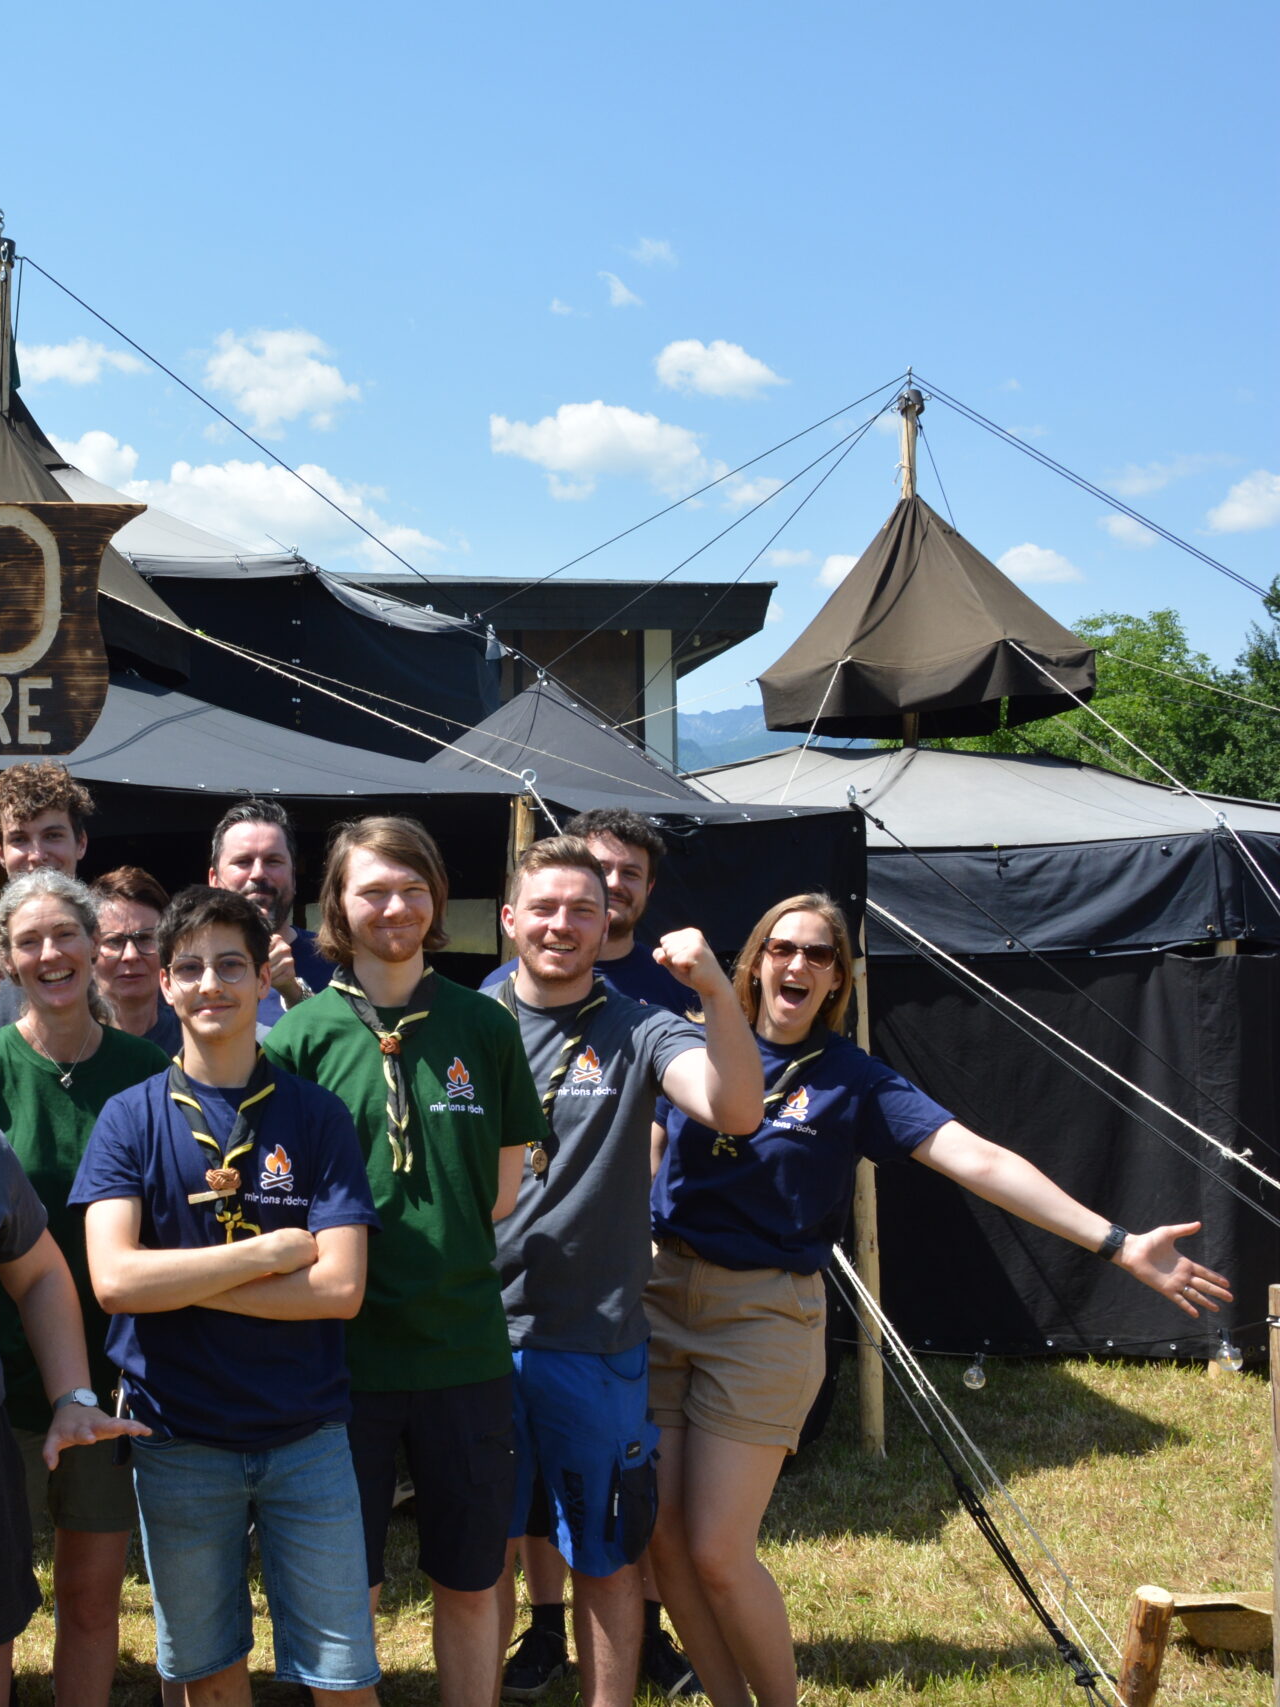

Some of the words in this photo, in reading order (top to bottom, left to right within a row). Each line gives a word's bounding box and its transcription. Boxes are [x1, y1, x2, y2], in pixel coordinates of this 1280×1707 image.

[571, 1086, 591, 1097] lons
[592, 1086, 617, 1097] röcha
[429, 1101, 447, 1112] mir
[448, 1102, 466, 1112] lons
[467, 1103, 485, 1115] röch
[772, 1119, 792, 1130] lons
[792, 1123, 818, 1136] röcha
[244, 1192, 260, 1202] mir
[260, 1193, 281, 1204] lons
[282, 1194, 309, 1207] röcha
